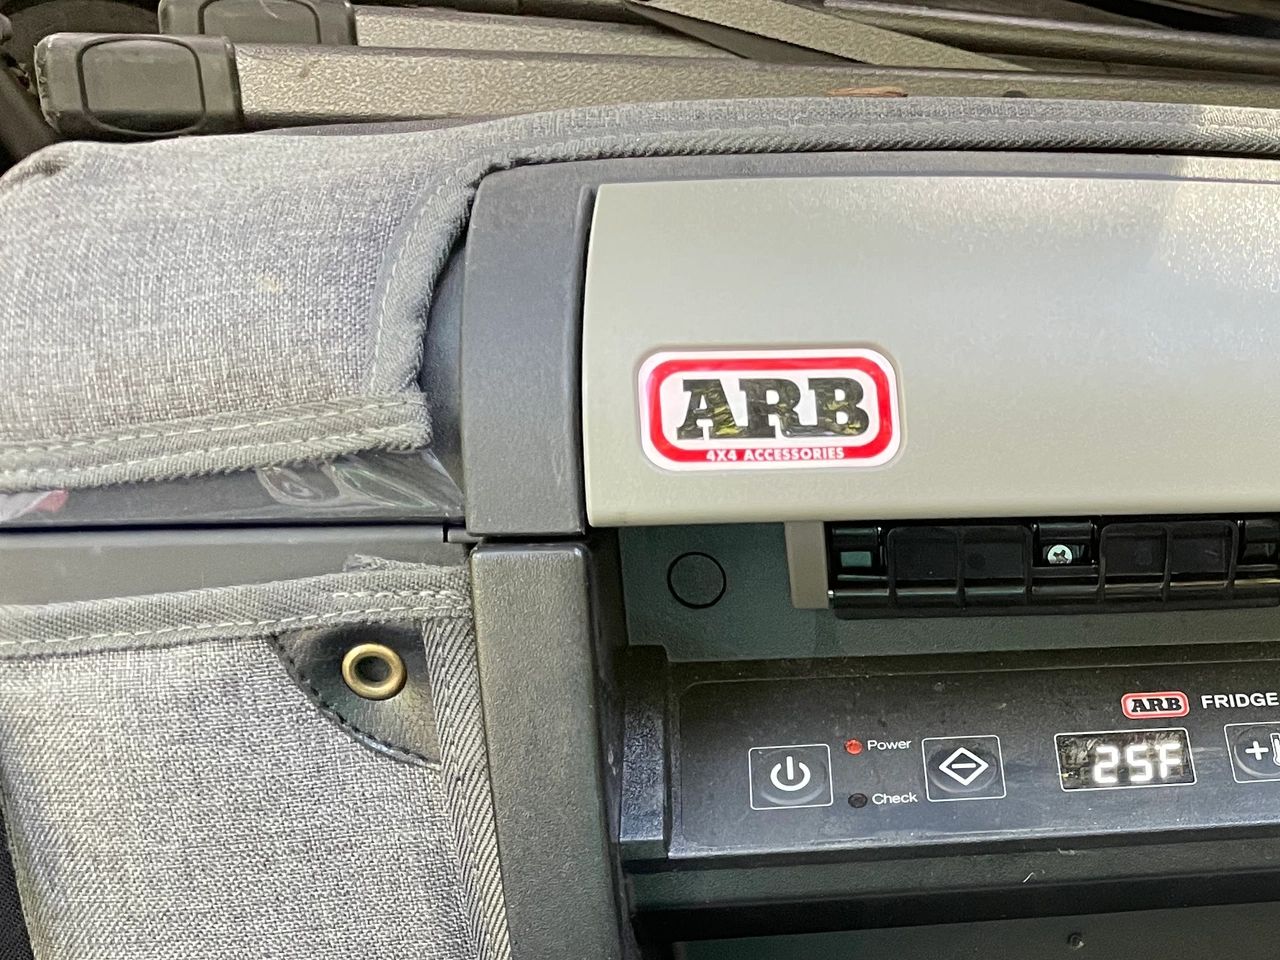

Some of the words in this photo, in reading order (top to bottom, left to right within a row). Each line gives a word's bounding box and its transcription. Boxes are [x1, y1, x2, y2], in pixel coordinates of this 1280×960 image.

[677, 378, 869, 440] ARB
[706, 449, 737, 462] 4X4
[743, 447, 845, 461] ACCESSORIES
[1130, 698, 1182, 713] ARB
[1201, 692, 1280, 709] FRIDGE
[867, 738, 912, 751] Power
[1092, 741, 1182, 784] 25F
[871, 792, 918, 806] Check
